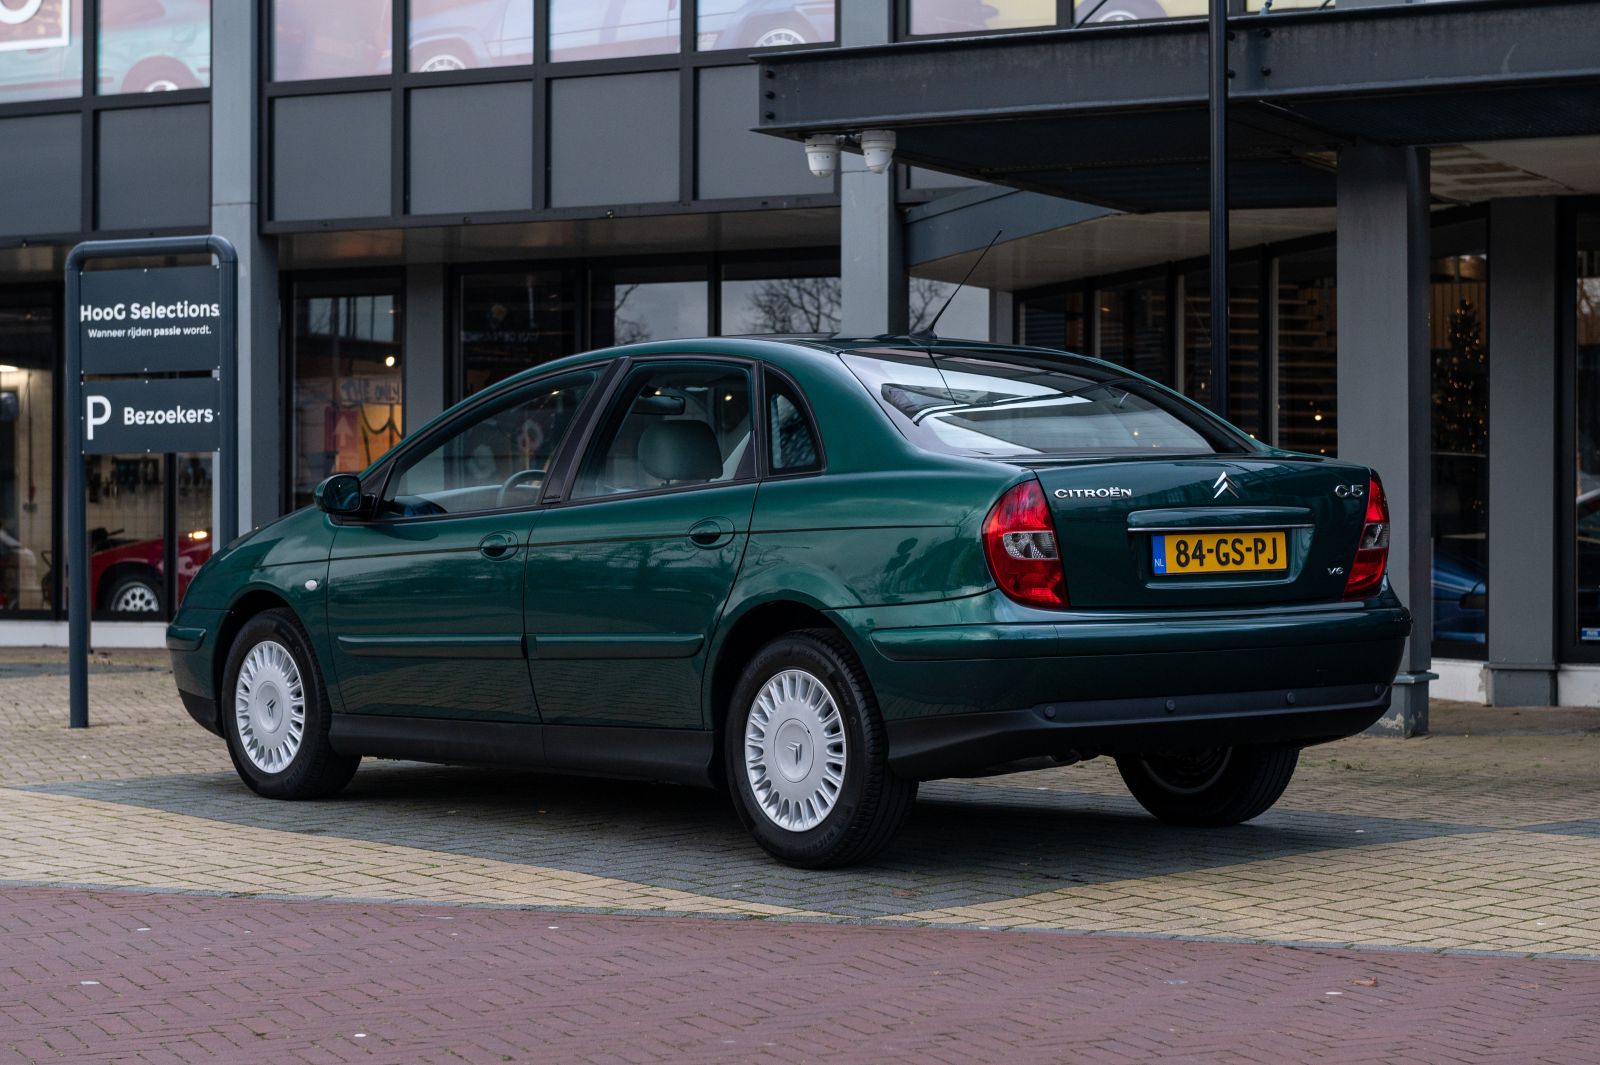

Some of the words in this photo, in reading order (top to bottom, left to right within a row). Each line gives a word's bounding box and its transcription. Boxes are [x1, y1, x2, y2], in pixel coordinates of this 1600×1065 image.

[80, 303, 126, 322] HooG
[130, 300, 220, 319] Selections
[88, 328, 125, 338] Wanneer
[127, 326, 151, 339] rijden
[153, 325, 181, 338] passie
[183, 324, 211, 335] wordt.
[86, 395, 112, 441] P
[123, 404, 214, 425] Bezoekers
[1054, 486, 1132, 499] CITROËN
[1334, 484, 1364, 498] C5
[1175, 537, 1278, 568] 84-GS-PJ
[1154, 558, 1164, 567] NL
[1327, 566, 1344, 576] V6
